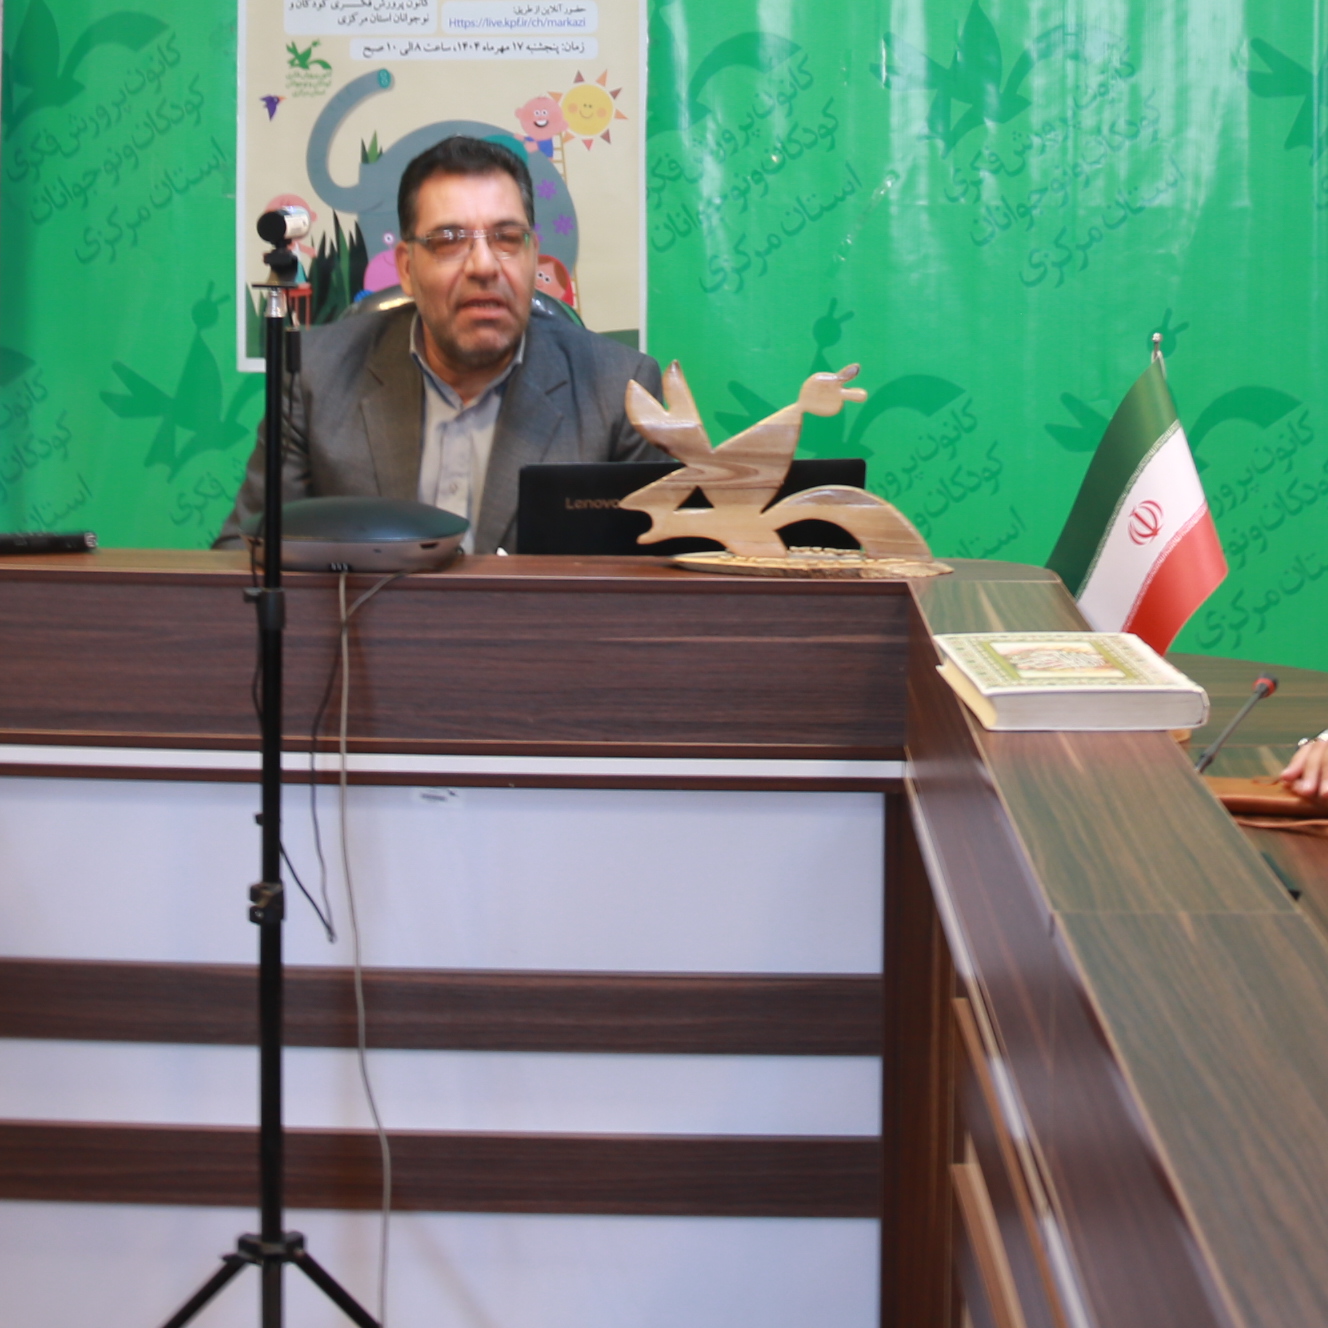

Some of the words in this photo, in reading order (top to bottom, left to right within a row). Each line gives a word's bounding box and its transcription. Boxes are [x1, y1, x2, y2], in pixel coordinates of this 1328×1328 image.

[337, 12, 368, 26] مرکزی
[370, 13, 392, 25] استان
[124, 31, 181, 95] کانون
[362, 45, 384, 59] صبح
[131, 73, 204, 151] کودکان
[6, 127, 61, 185] فکری
[149, 136, 227, 209] استان
[646, 152, 684, 210] فکر
[781, 161, 862, 237] استان
[75, 205, 152, 264] مرکزی
[1019, 226, 1103, 288] مرکزی
[914, 396, 980, 462] کانون
[1252, 409, 1315, 477] کانون
[565, 497, 620, 510] Lenovo
[1195, 587, 1281, 651] مرکزی
